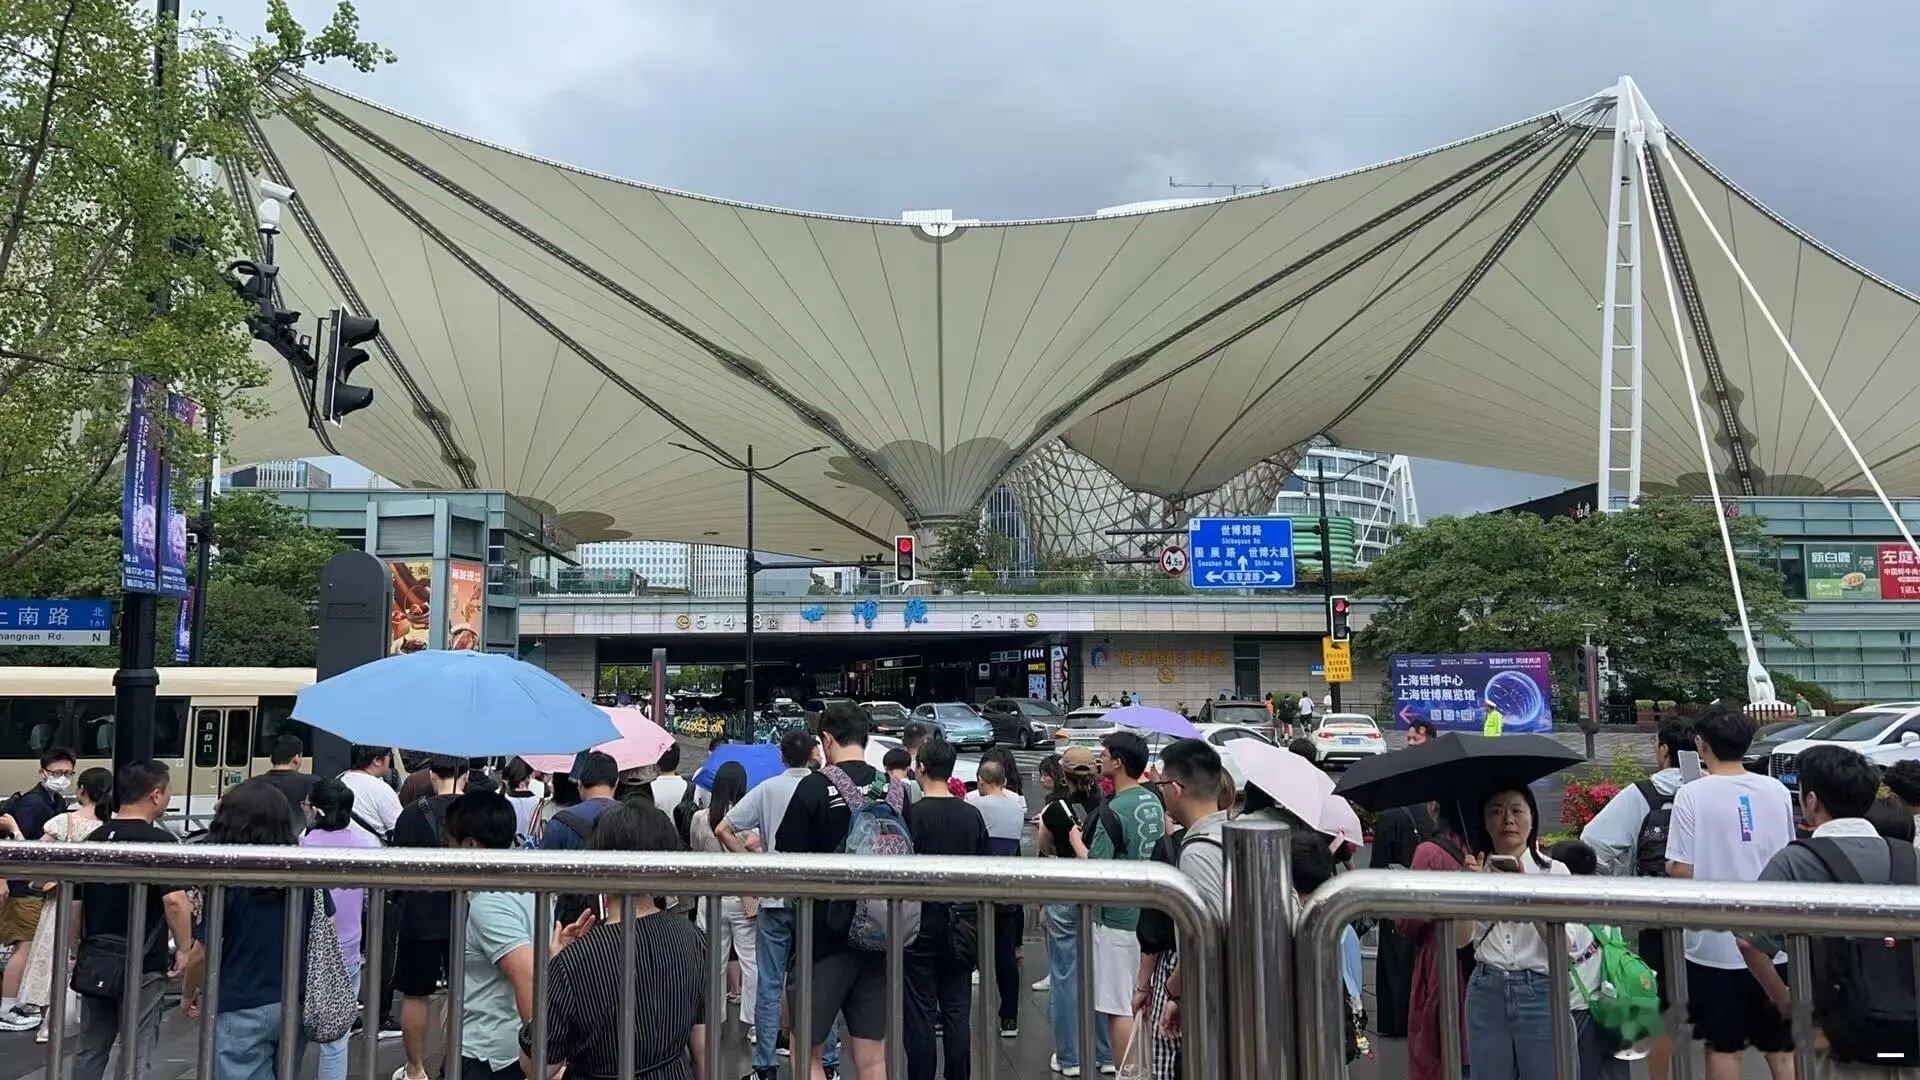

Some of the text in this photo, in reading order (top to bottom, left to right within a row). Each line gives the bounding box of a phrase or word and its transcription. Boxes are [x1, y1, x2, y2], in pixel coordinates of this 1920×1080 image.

[1221, 525, 1262, 536] 世博馆路
[1249, 547, 1290, 558] 世博大道
[1883, 568, 1920, 576] 中国鲜牛肉
[92, 606, 104, 617] 北
[89, 619, 105, 627] 161
[92, 633, 101, 642] N
[1398, 674, 1463, 687] 上海世博中心
[1398, 688, 1476, 701] 上海世博展览馆
